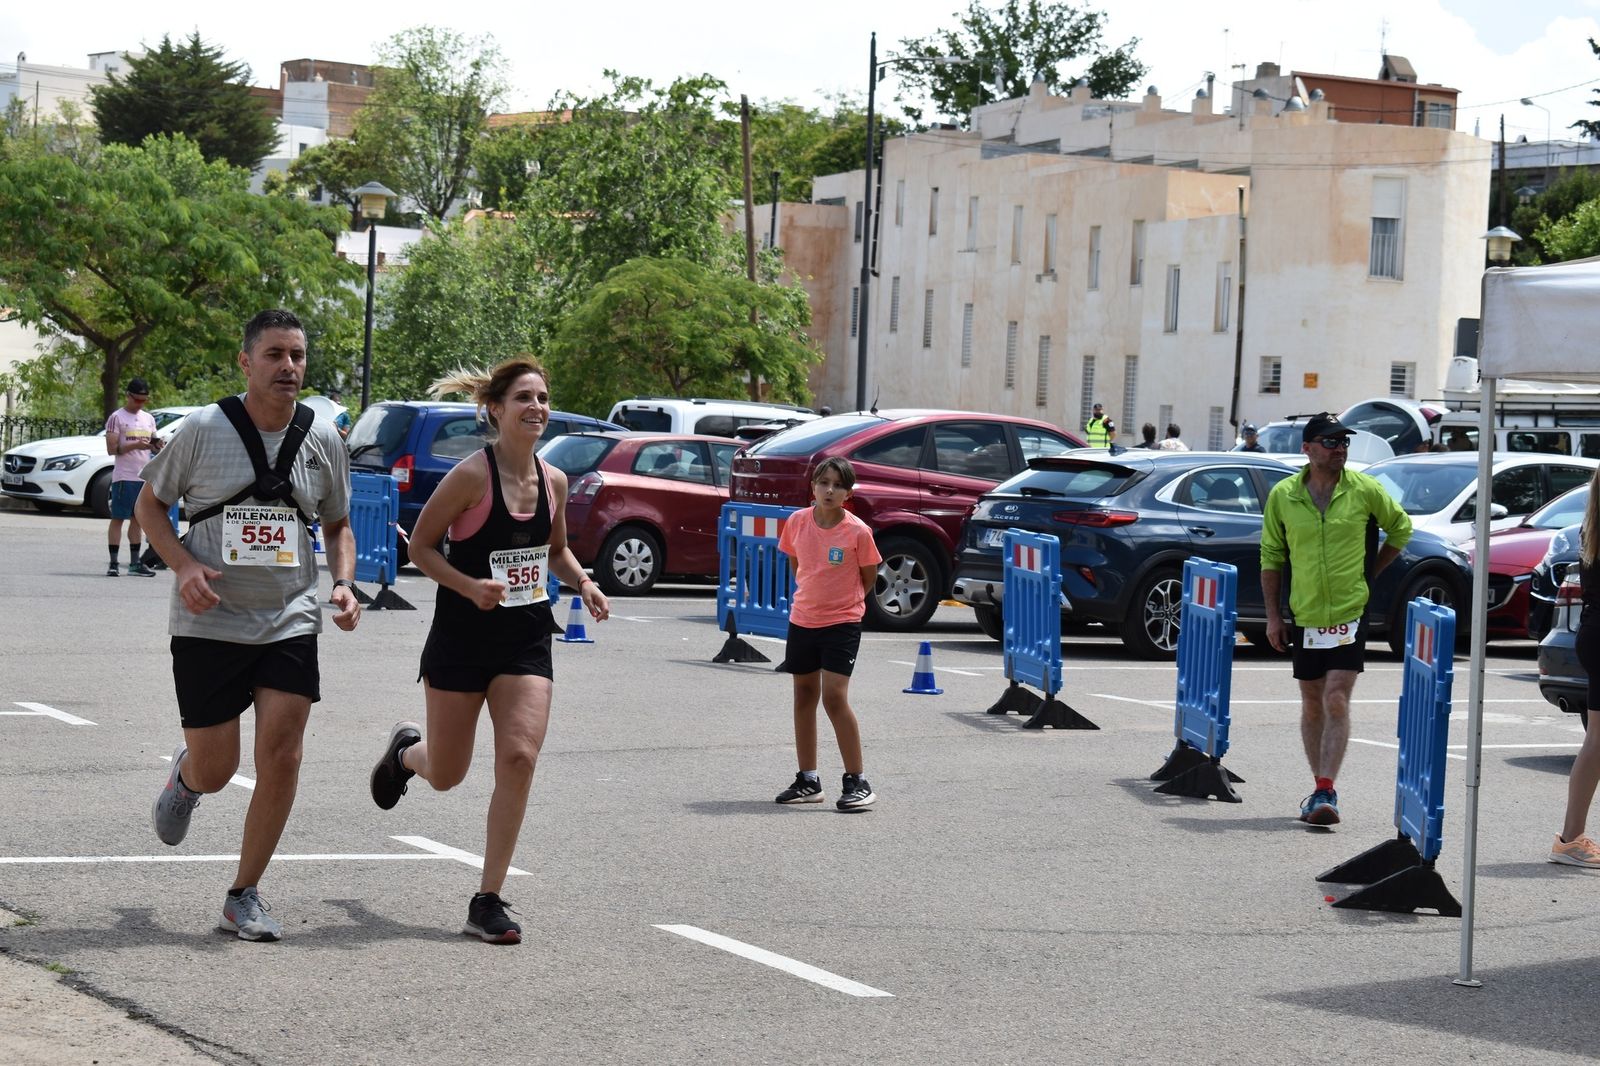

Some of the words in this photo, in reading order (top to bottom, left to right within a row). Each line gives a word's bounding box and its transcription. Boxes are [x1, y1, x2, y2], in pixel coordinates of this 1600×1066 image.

[226, 512, 295, 522] MILENARIA
[241, 525, 286, 545] 554
[491, 552, 546, 565] MILENARIA
[507, 565, 540, 586] 556
